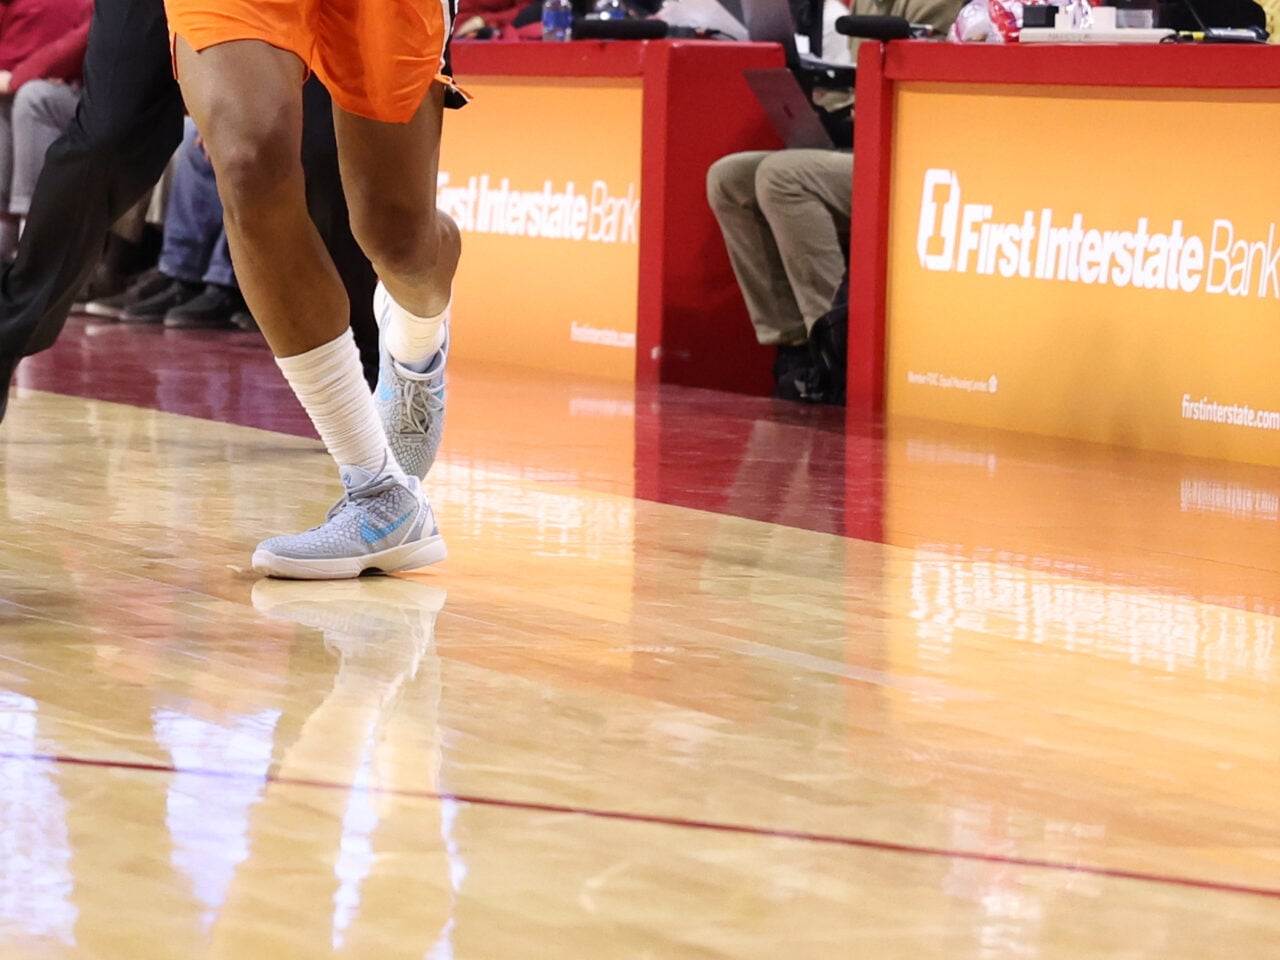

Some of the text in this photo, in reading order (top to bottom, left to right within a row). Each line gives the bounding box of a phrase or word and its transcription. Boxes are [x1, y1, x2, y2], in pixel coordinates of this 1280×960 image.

[476, 174, 589, 240] Interstate
[587, 180, 639, 244] Bank
[956, 203, 1280, 300] First Interstate Bank
[1181, 393, 1280, 430] firstinterstate.com
